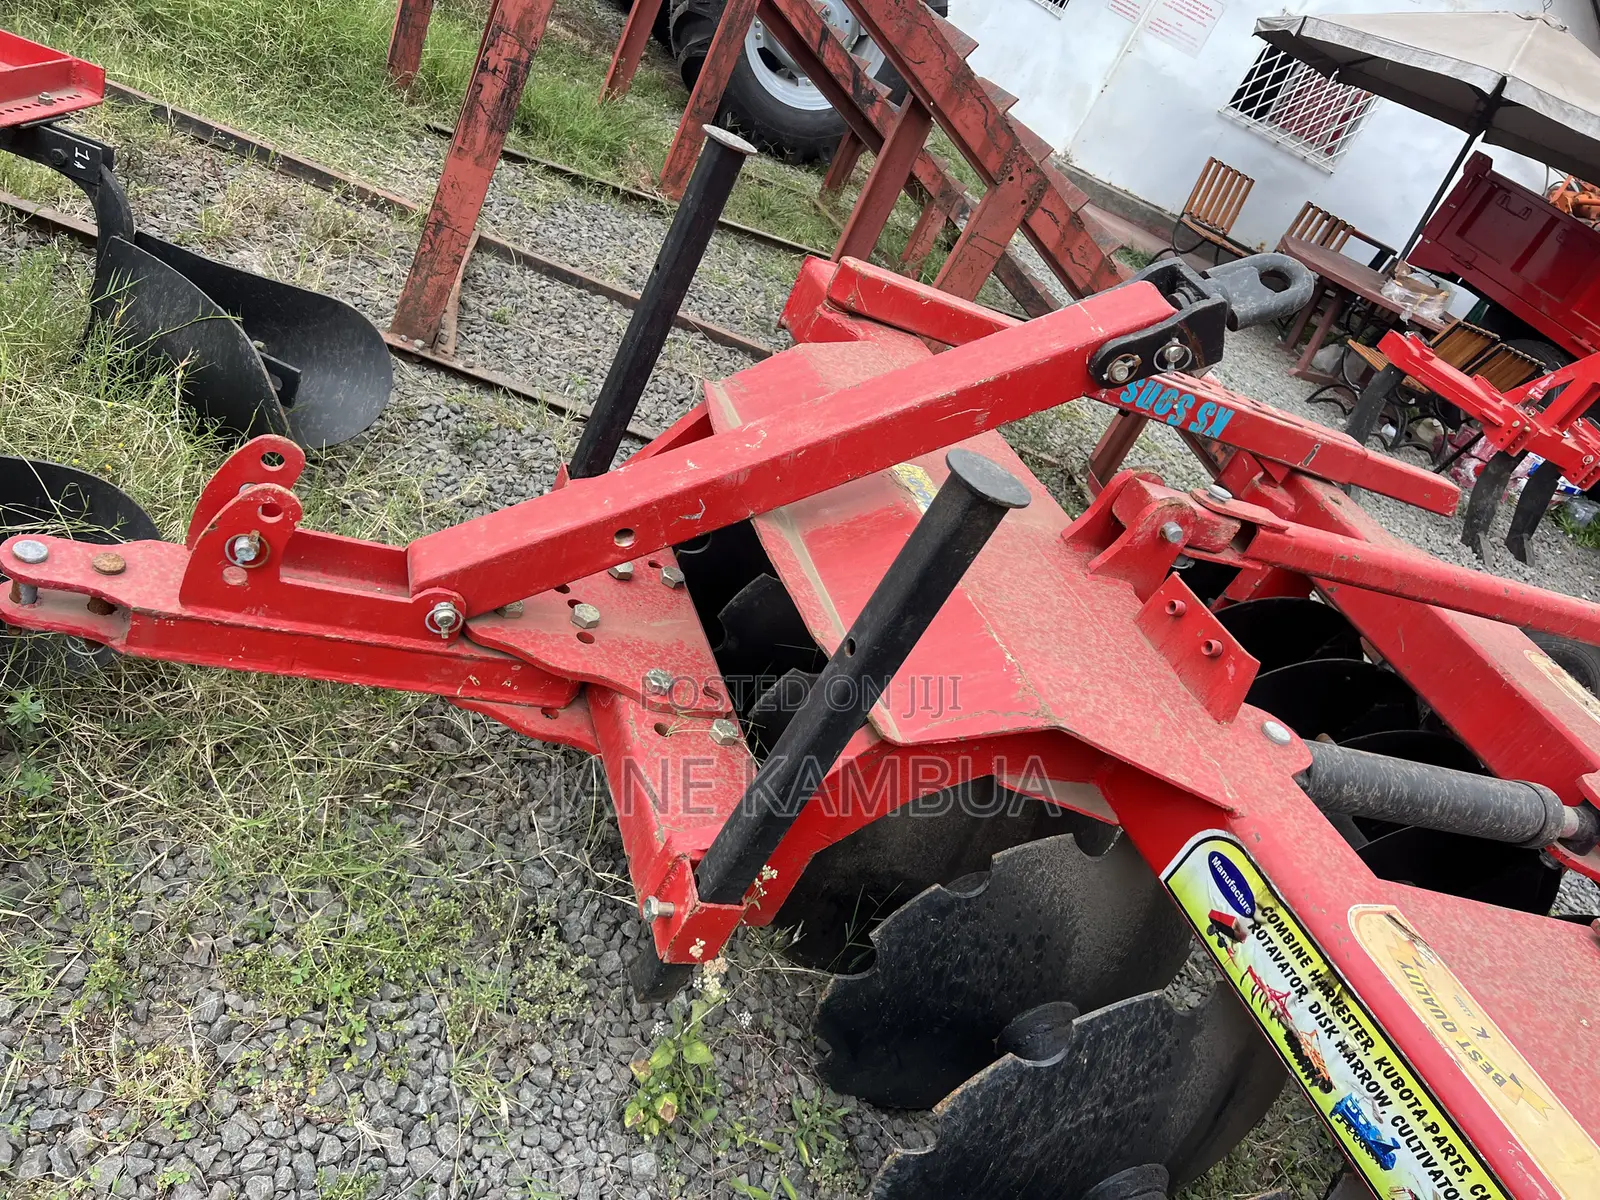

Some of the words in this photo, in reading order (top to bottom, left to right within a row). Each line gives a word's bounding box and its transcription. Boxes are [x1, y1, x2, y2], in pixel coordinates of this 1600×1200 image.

[1188, 401, 1235, 439] KS
[1211, 856, 1252, 915] Manufacture
[1397, 960, 1458, 1033] QUALITY
[1248, 923, 1308, 1003] ROTAVATOR,
[1308, 1002, 1340, 1039] DISK
[1335, 1040, 1393, 1115] HARROW,
[1391, 1115, 1464, 1200] CULTIVATO
[1261, 906, 1313, 968] COMBINE
[1308, 969, 1375, 1056] HARVESTER,
[1374, 1056, 1428, 1122] KUBOTA
[1424, 1122, 1472, 1182] PARTS,
[1456, 1040, 1507, 1087] BEST
